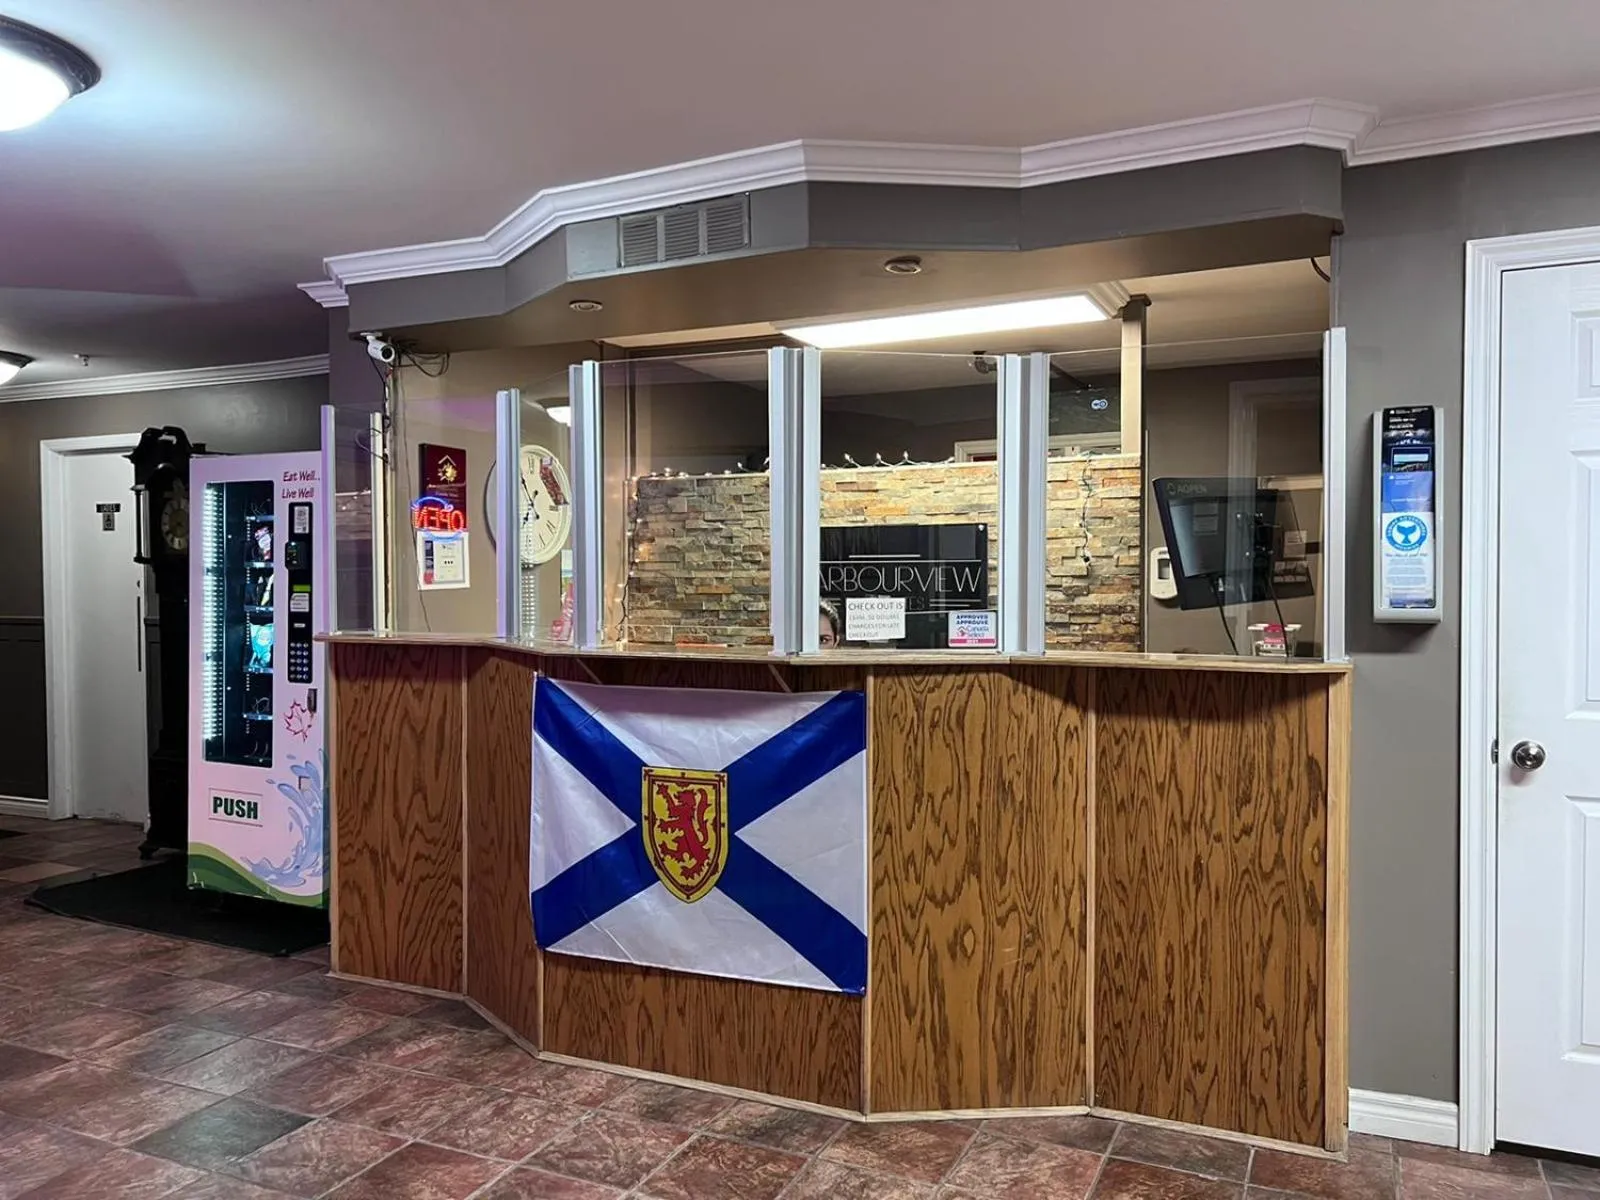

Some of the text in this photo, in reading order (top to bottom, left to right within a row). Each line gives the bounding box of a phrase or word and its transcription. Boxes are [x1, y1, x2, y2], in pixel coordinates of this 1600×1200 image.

[283, 470, 298, 481] Eat
[282, 487, 315, 498] Live Well
[848, 601, 904, 610] CHECK OUT IS
[213, 796, 258, 820] PUSH
